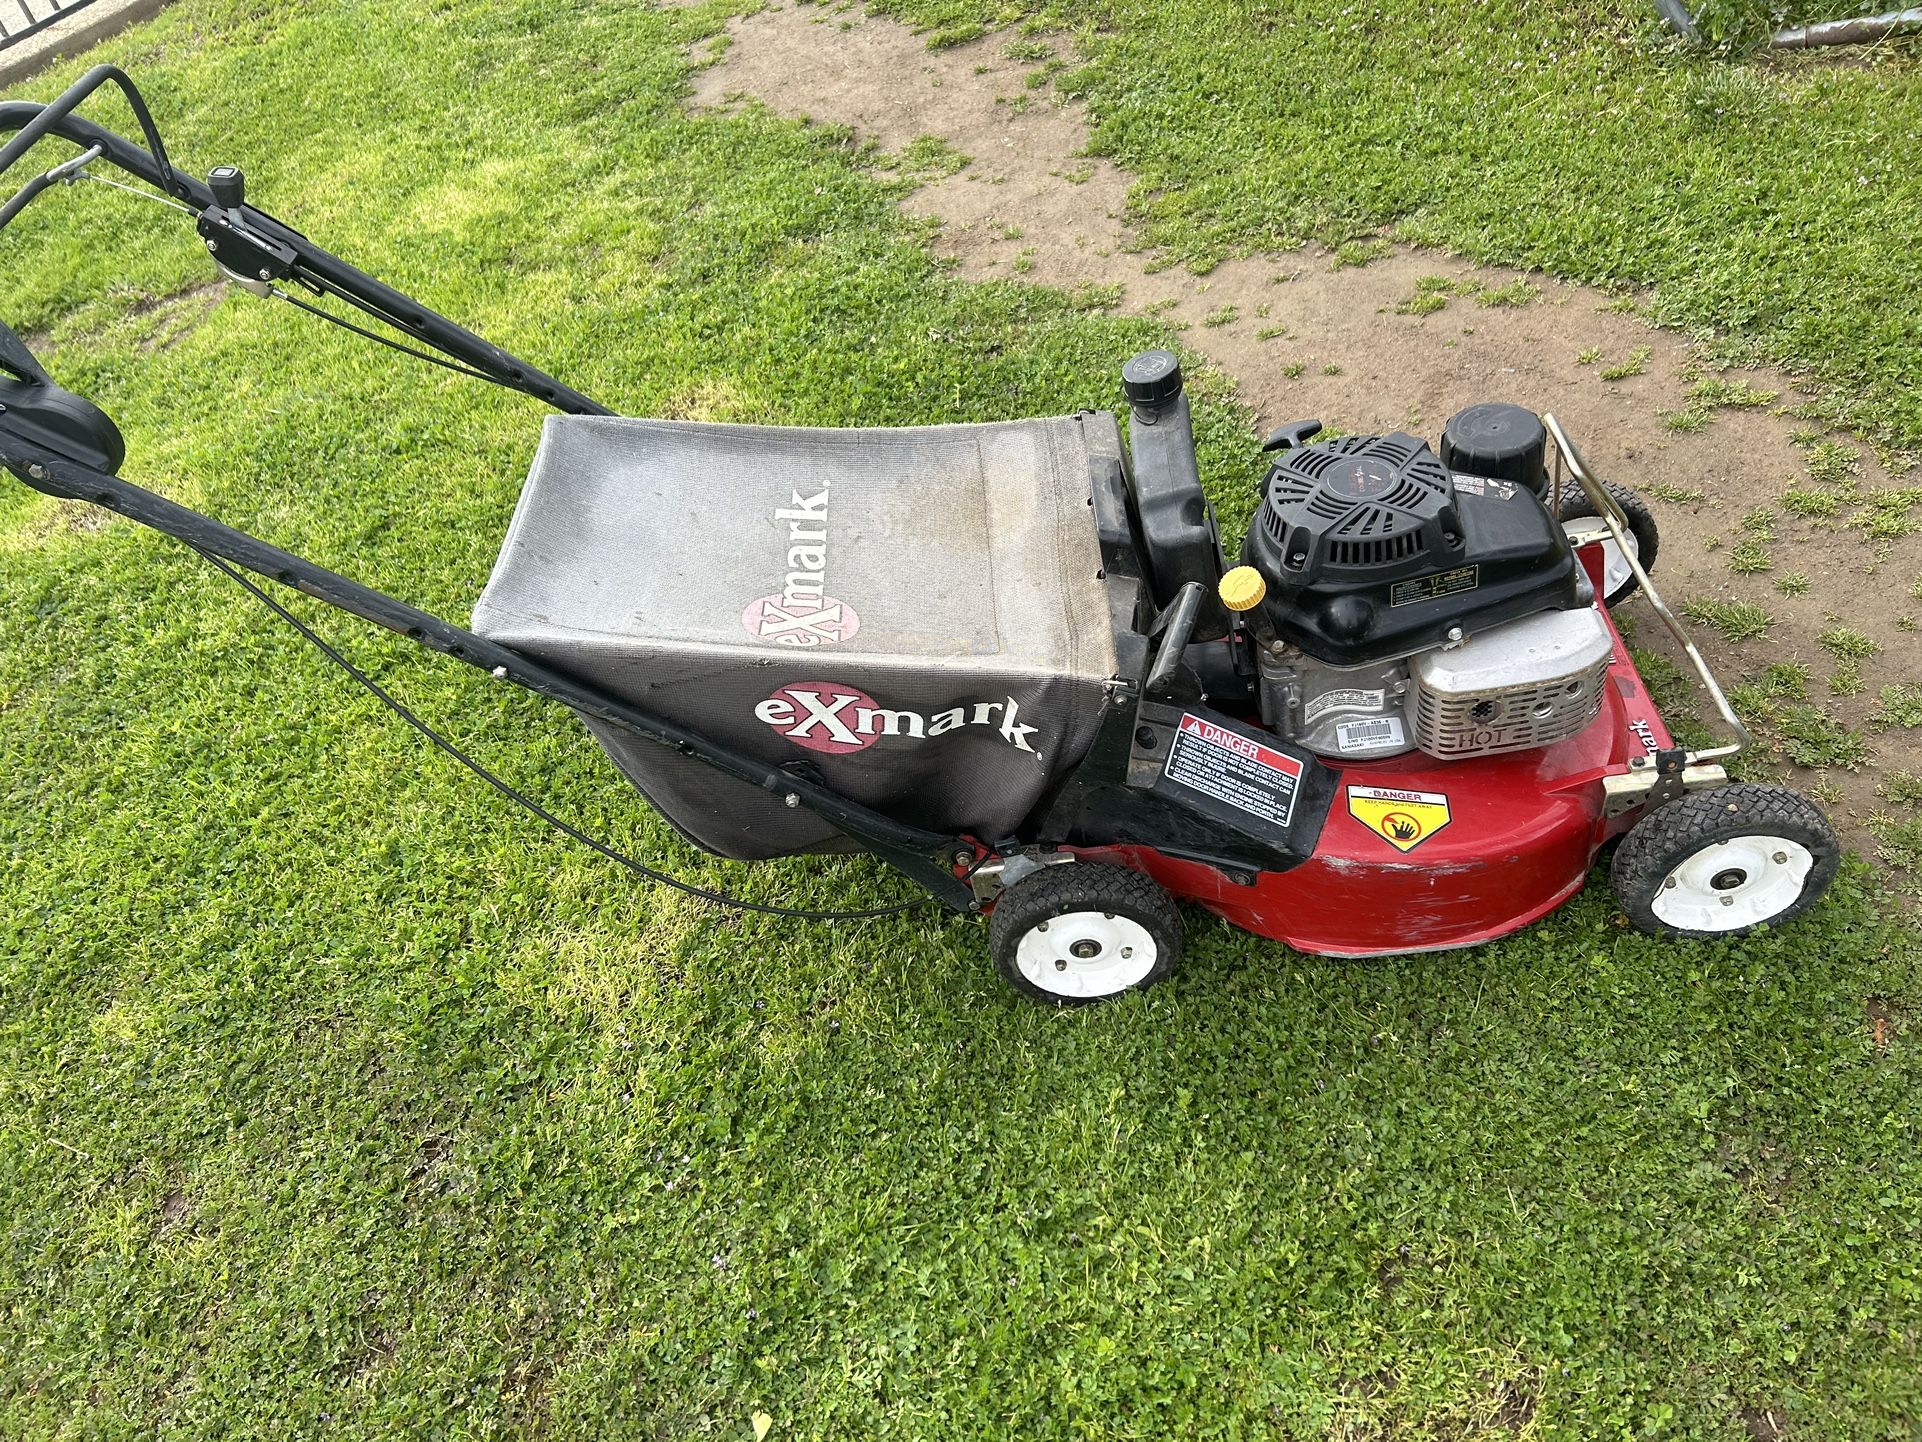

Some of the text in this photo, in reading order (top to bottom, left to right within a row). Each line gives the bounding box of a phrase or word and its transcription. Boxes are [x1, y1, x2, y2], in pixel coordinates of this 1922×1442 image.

[755, 689, 1039, 753] eXmark
[1204, 726, 1259, 758] DANGER
[1459, 728, 1507, 748] HOT
[1178, 756, 1200, 768] OPERATE
[1202, 766, 1215, 775] ONLY
[1221, 774, 1235, 783] DOOR
[1242, 783, 1274, 800] COMPLETELY
[1179, 749, 1207, 764] SERIOUSLY
[1181, 744, 1203, 756] THROWN
[1204, 754, 1225, 766] OBJECTS
[1238, 769, 1254, 779] BLADE
[1255, 776, 1278, 789] CONTACT
[1183, 738, 1201, 750] RESULT
[1207, 749, 1221, 758] DOOR
[1239, 763, 1271, 780] COMPLETELY
[1272, 777, 1293, 790] CLOSED.
[1184, 734, 1205, 746] THROWN
[1206, 744, 1228, 756] OBJECTS
[1241, 758, 1256, 768] BLADE
[1258, 766, 1280, 779] CONTACT
[1173, 772, 1192, 783] MOVING
[1193, 780, 1208, 790] DOOR
[1208, 787, 1228, 799] HANDLE
[1229, 796, 1243, 805] BACK
[1174, 767, 1191, 777] CLEAR
[1192, 774, 1220, 789] DISCHARGE
[1221, 787, 1234, 795] WITH
[1235, 793, 1253, 803] ENGINE
[1253, 801, 1276, 814] STOPPED
[1176, 760, 1196, 772] CLOSED
[1205, 773, 1236, 790] ATTACHMENT
[1243, 790, 1263, 801] LOCKED
[1270, 801, 1287, 812] PLACE.
[1373, 790, 1422, 801] DANGER
